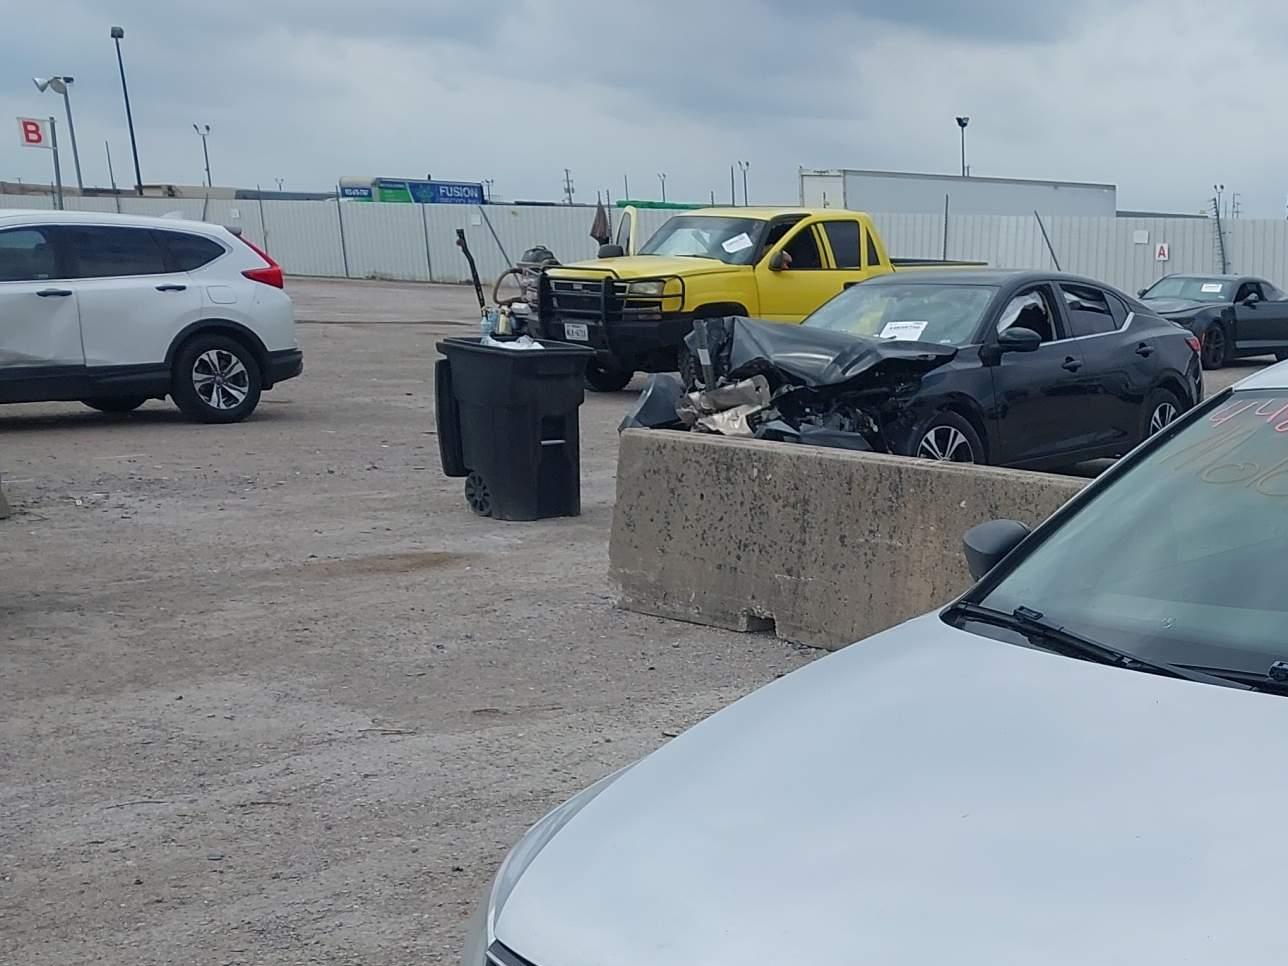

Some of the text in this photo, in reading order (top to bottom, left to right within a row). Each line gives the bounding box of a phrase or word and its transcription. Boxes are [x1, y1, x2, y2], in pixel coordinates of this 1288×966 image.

[22, 120, 43, 144] B
[439, 185, 479, 198] FUSION
[1157, 245, 1167, 258] A
